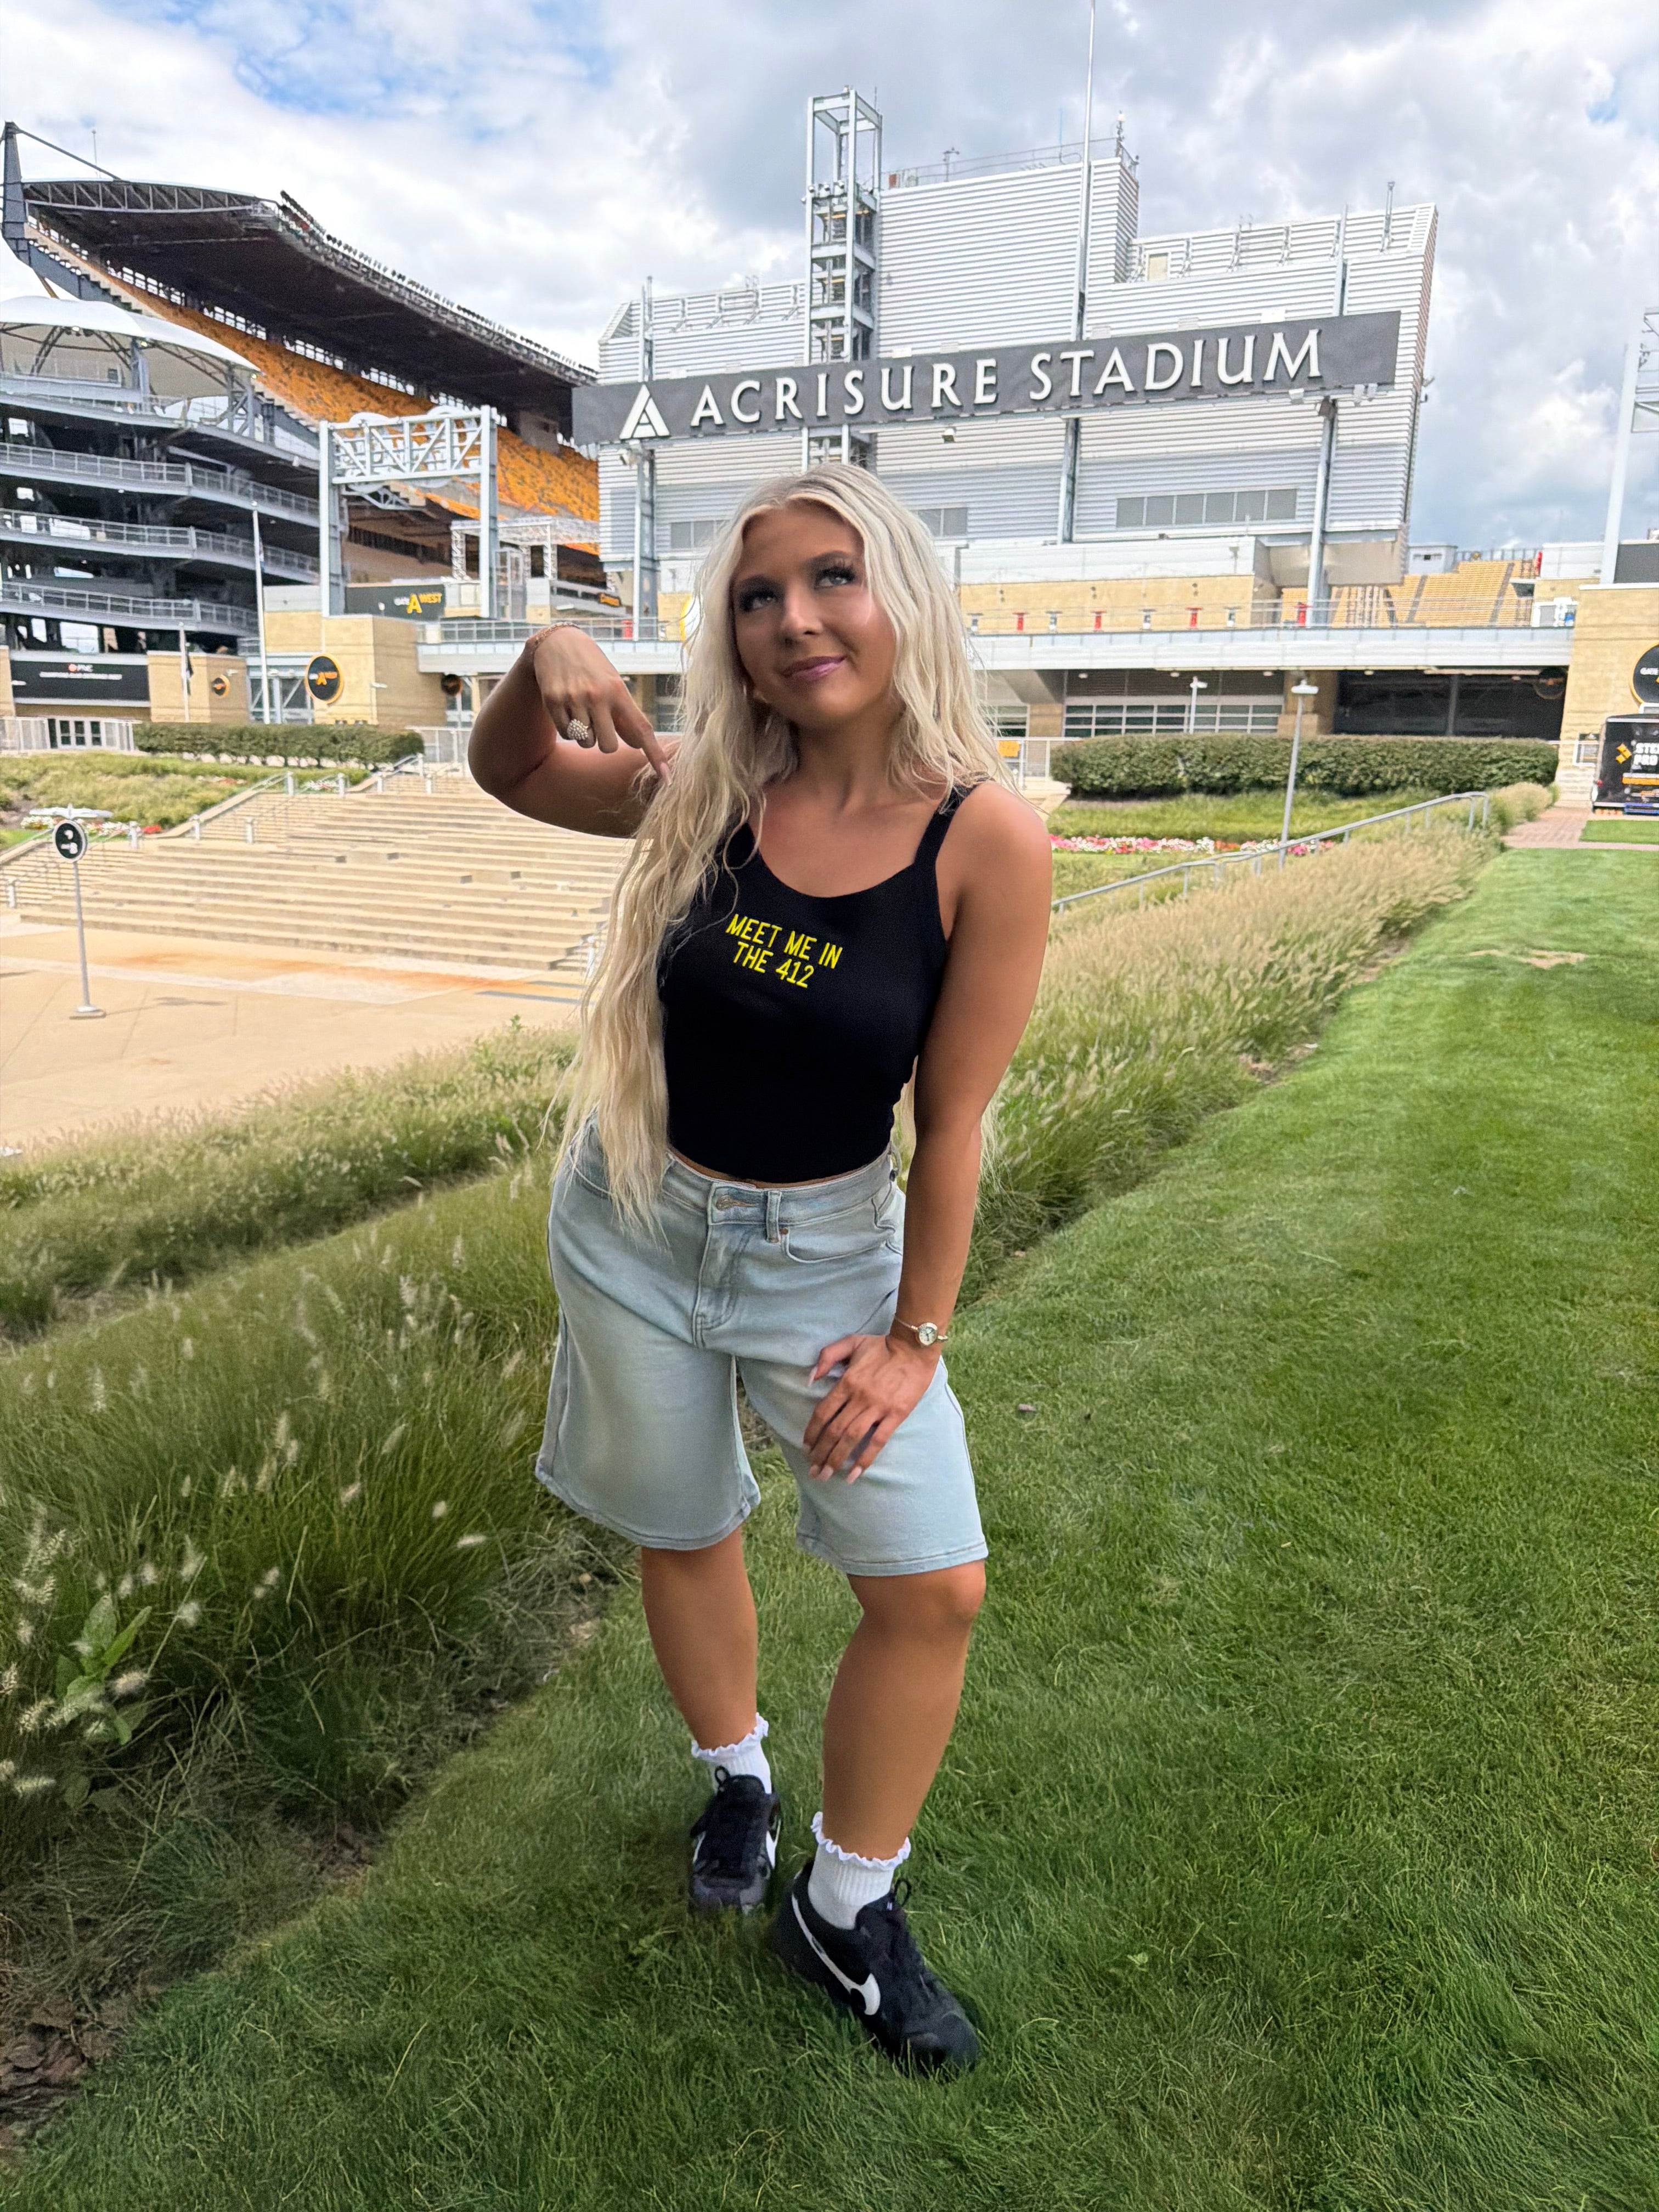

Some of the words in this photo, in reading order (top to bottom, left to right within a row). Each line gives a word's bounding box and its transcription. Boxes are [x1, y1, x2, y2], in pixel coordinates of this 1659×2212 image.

[690, 358, 998, 427] ACRISURE
[1029, 329, 1322, 401] STADIUM
[407, 594, 422, 614] A
[419, 592, 442, 603] WEST
[1635, 742, 1659, 754] STE
[725, 913, 783, 948] MEET
[783, 930, 817, 961] ME
[818, 942, 843, 969] IN
[733, 941, 774, 973] THE
[775, 958, 815, 989] 412
